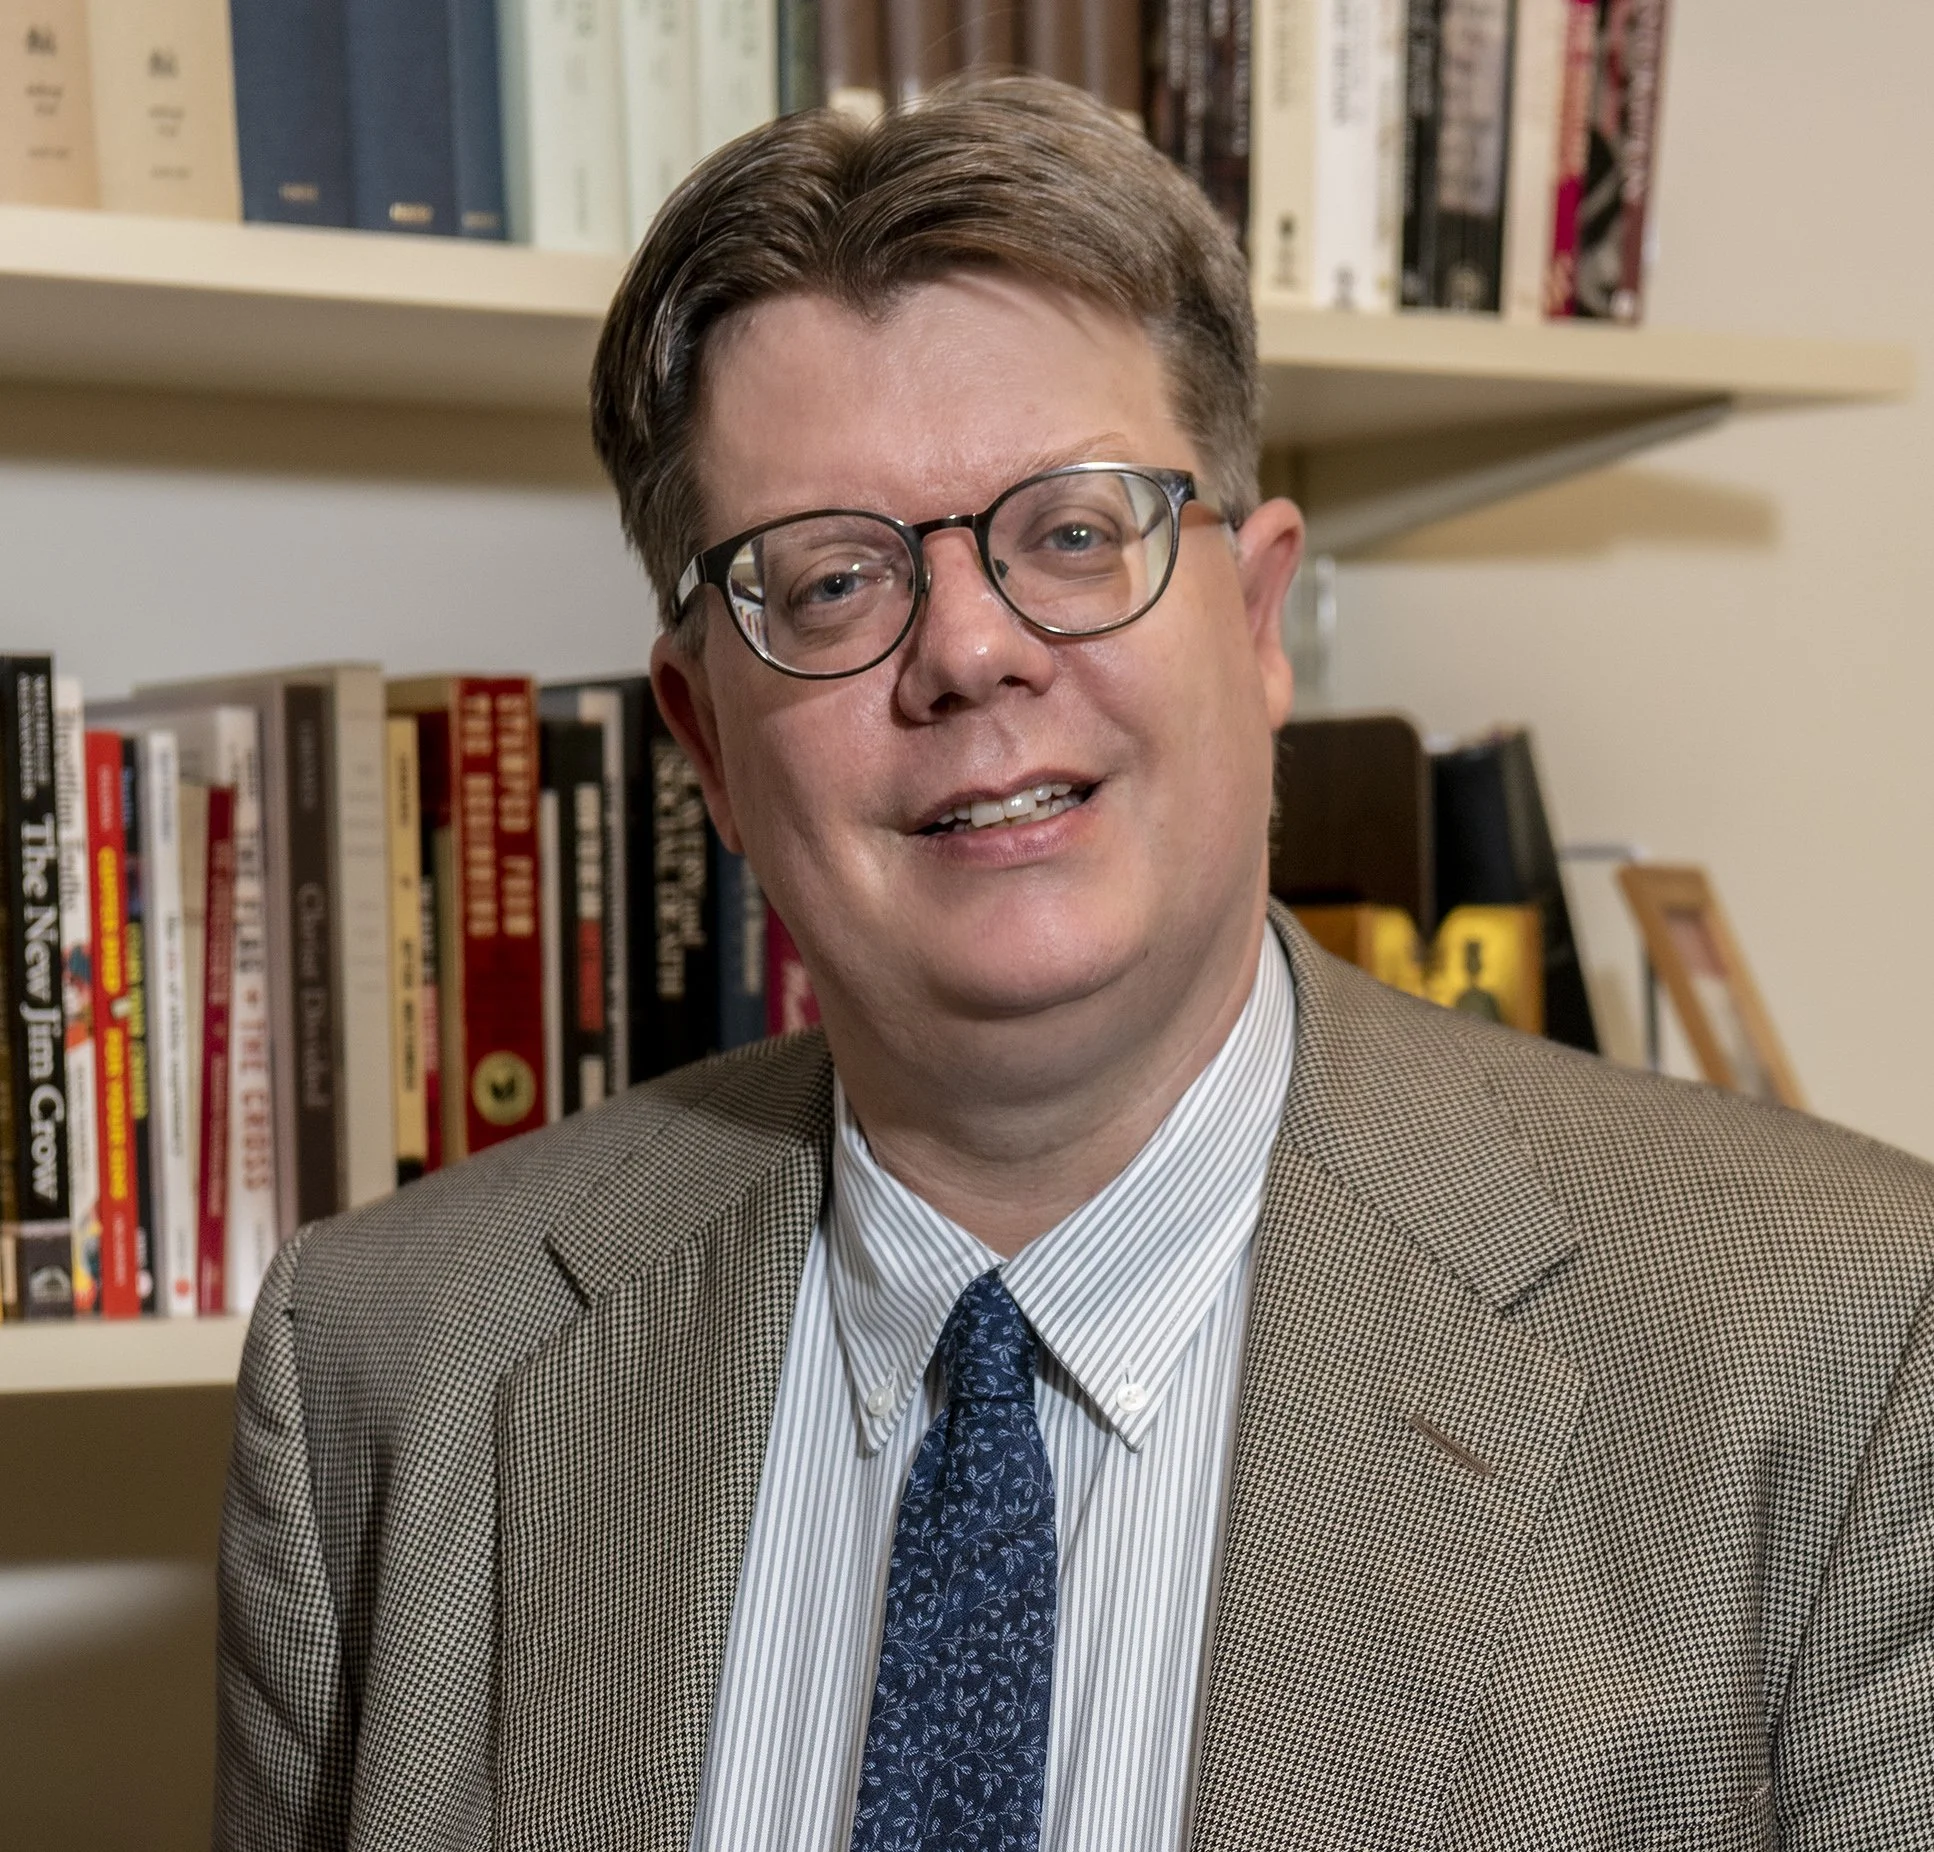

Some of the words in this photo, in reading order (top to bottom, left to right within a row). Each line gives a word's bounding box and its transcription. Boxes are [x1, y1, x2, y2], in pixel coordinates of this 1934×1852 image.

[462, 693, 492, 757] THE
[496, 692, 531, 833] STAMPED
[21, 811, 57, 900] The
[464, 771, 498, 938] BEGINNING
[500, 854, 534, 938] FROM
[24, 903, 60, 1001] New
[297, 882, 325, 980] Christ
[20, 1001, 62, 1082] Jim
[242, 1020, 266, 1072] THE
[300, 986, 331, 1107] Divided
[29, 1083, 65, 1202] Crow
[243, 1087, 269, 1191] CROSS
